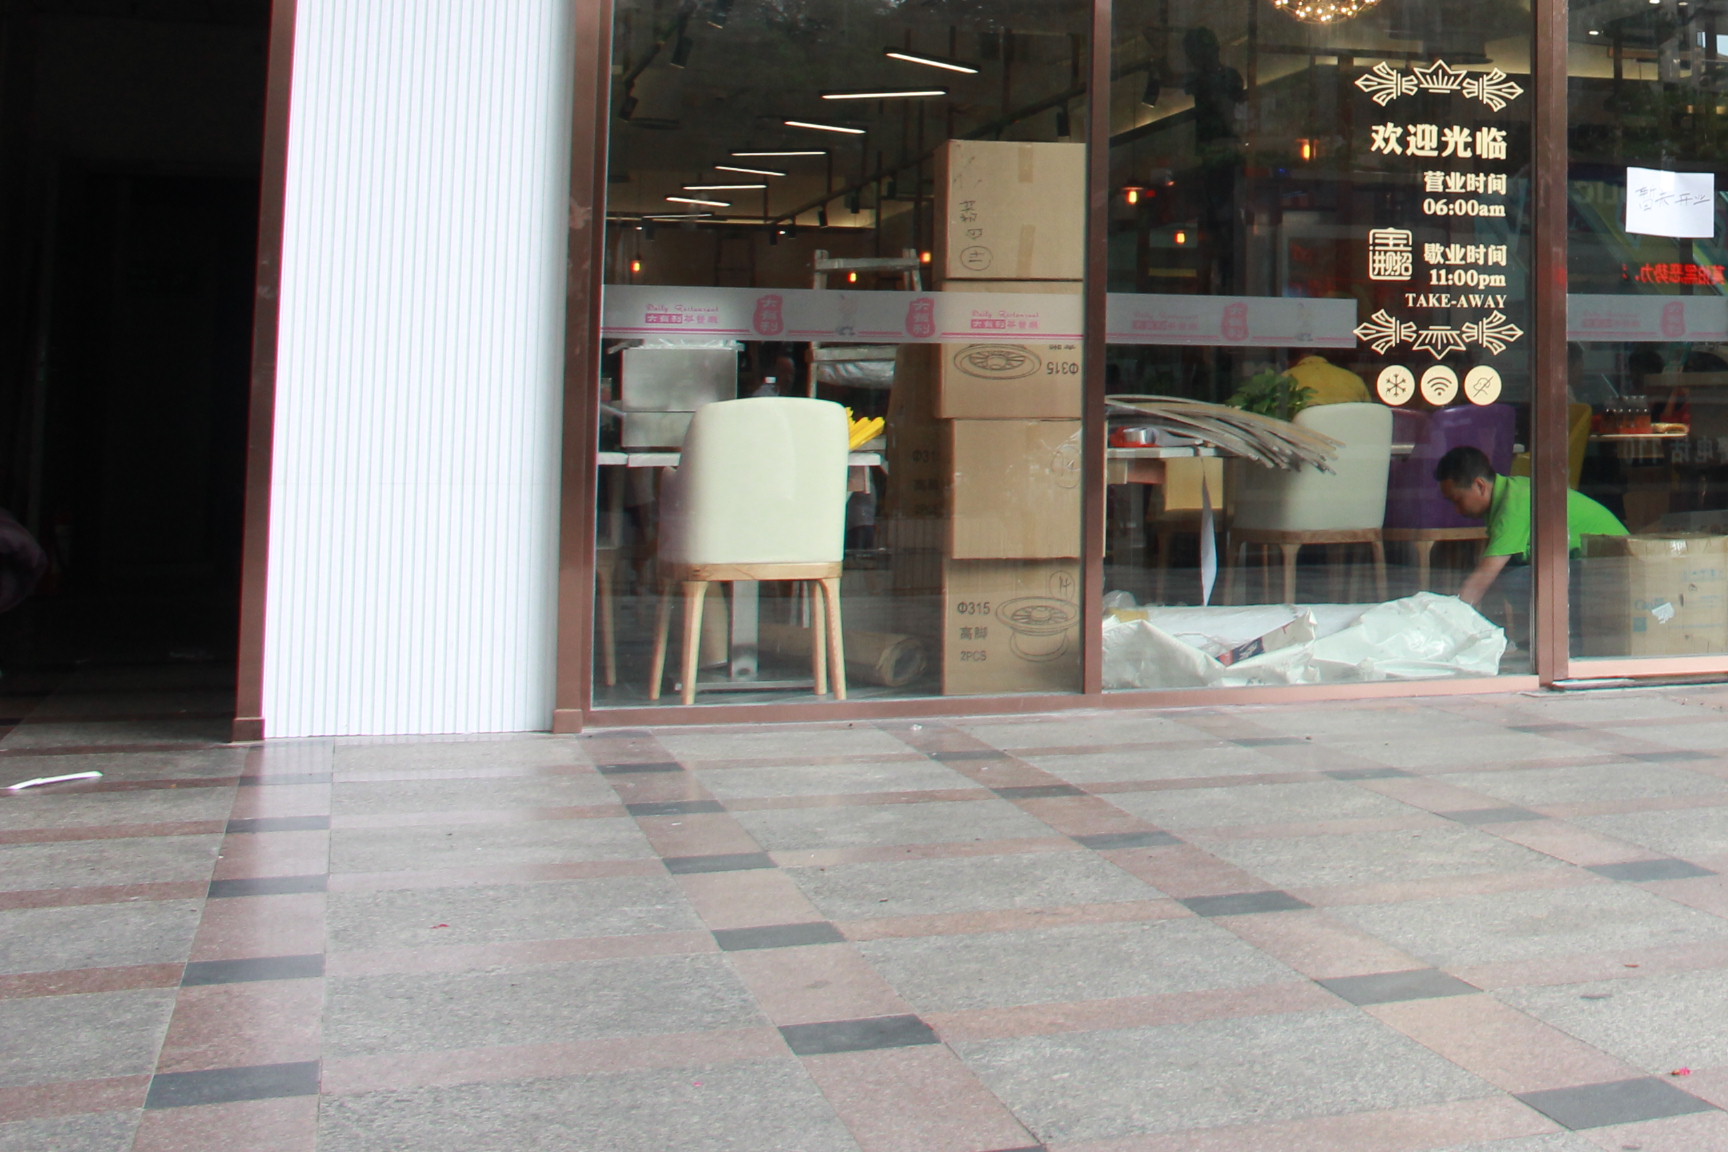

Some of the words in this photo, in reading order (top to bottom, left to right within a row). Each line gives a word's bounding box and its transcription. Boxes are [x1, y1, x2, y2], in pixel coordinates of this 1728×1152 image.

[1370, 122, 1508, 160] 欢迎光临
[1423, 170, 1508, 196] 营业时间
[1423, 198, 1506, 217] 06:00am
[1423, 243, 1508, 267] 歇业时间
[1429, 268, 1507, 290] 11:00pm
[1405, 292, 1508, 309] TAKE-AWAY
[959, 626, 988, 641] 高脚
[959, 650, 987, 662] 2PCS
